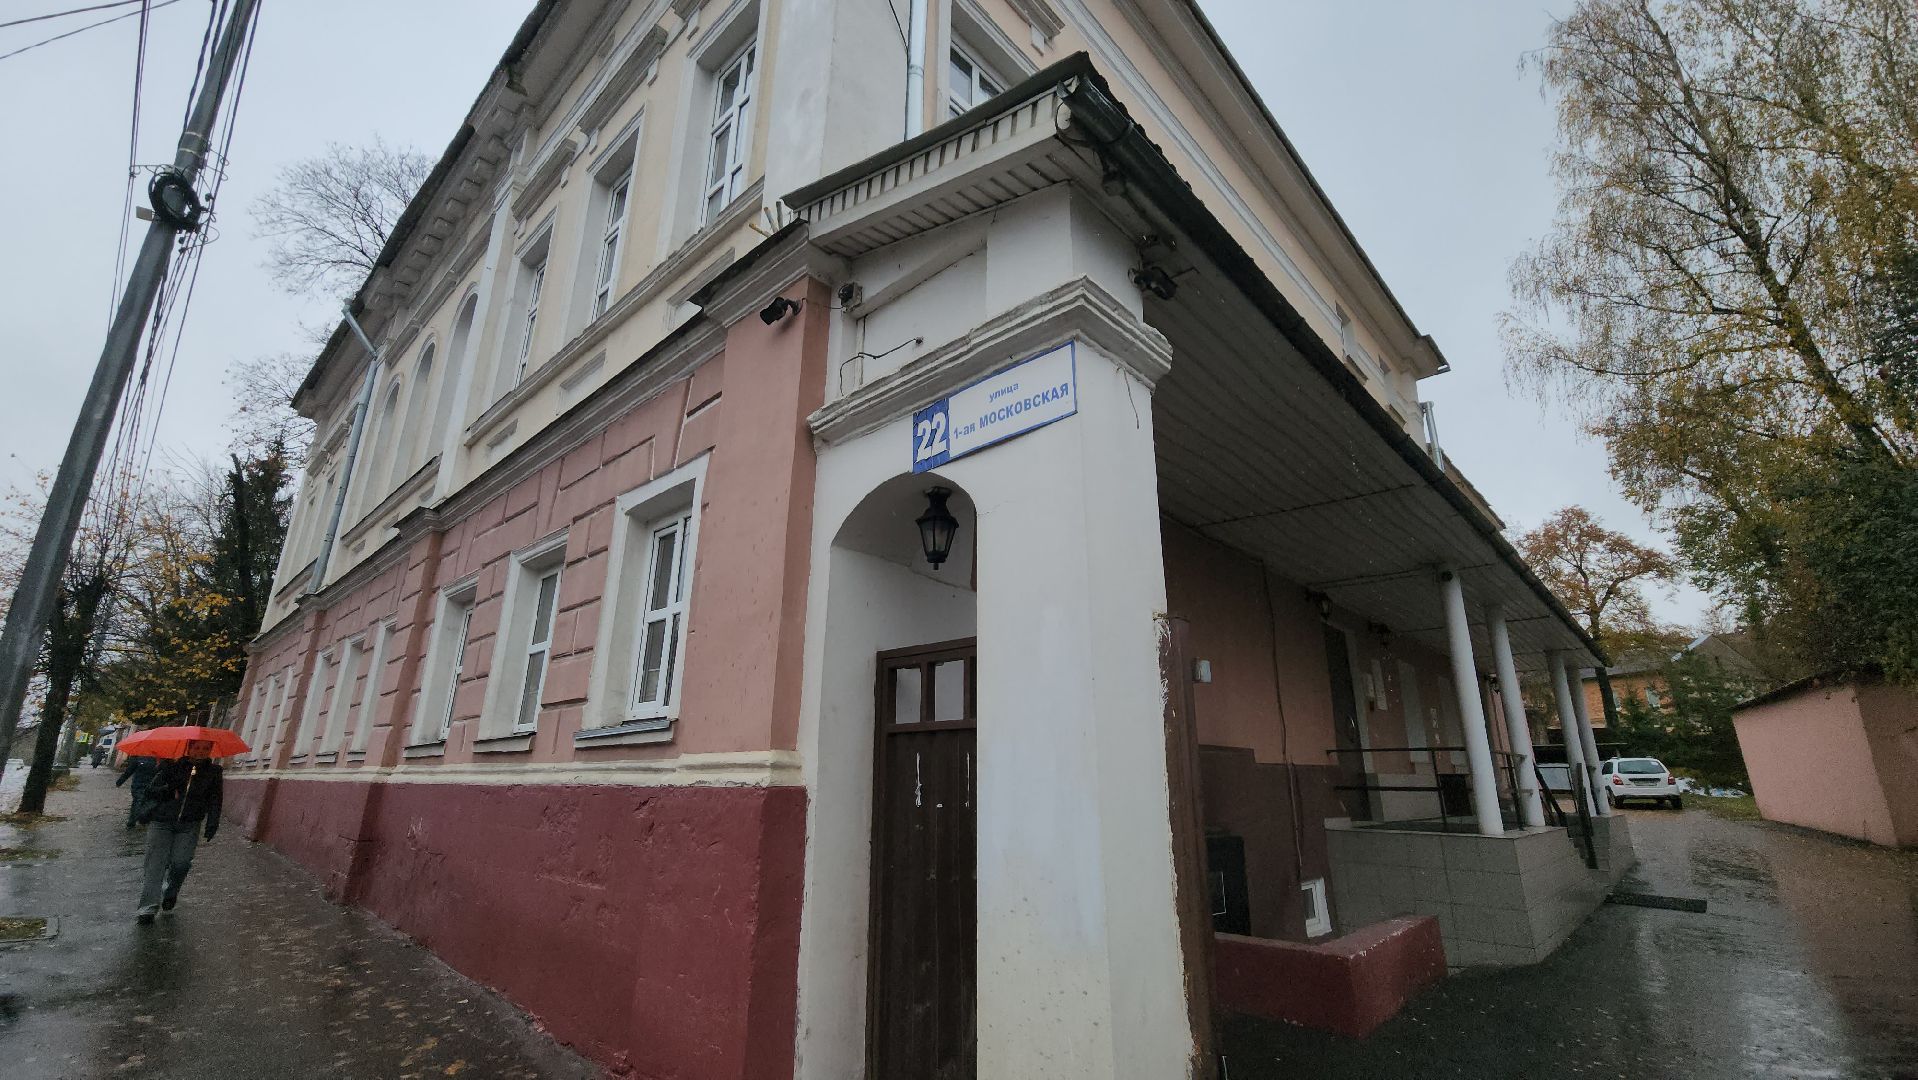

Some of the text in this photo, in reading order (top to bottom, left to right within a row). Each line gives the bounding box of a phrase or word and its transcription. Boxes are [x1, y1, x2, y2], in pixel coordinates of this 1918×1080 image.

[953, 382, 1069, 440] 1-ая МОСКОВСКАЯ
[989, 383, 1019, 403] улица
[915, 412, 948, 465] 22
